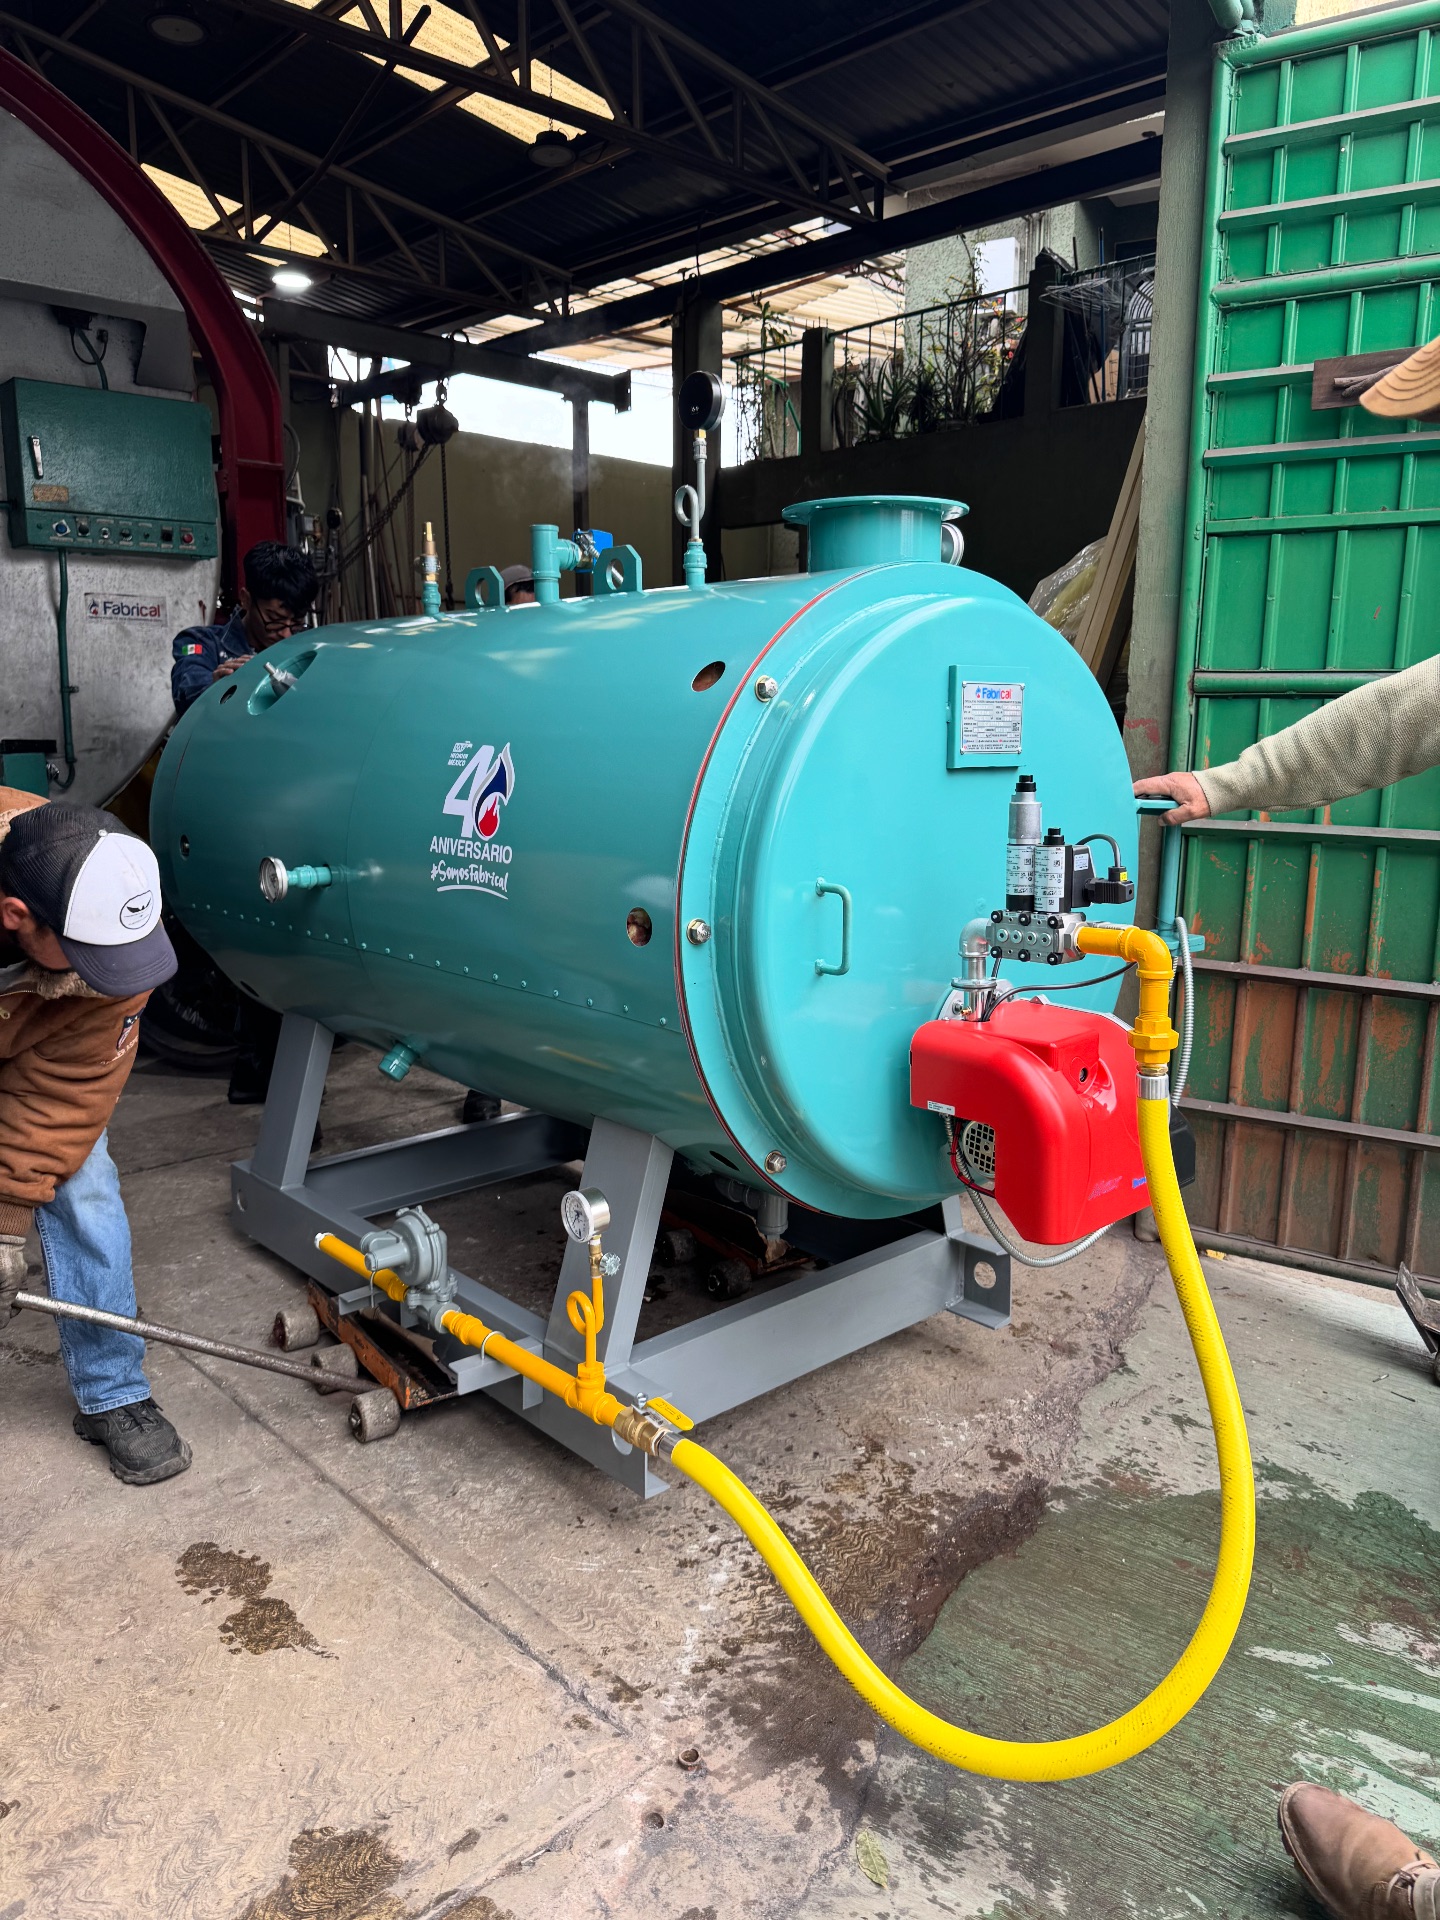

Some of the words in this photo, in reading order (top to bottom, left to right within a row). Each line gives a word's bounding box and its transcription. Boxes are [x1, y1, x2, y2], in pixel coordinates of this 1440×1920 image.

[103, 601, 161, 618] Fabrical
[982, 687, 1012, 699] Fabrical
[430, 835, 513, 864] ANIVERSARIO
[431, 859, 509, 893] #SomosFabrical
